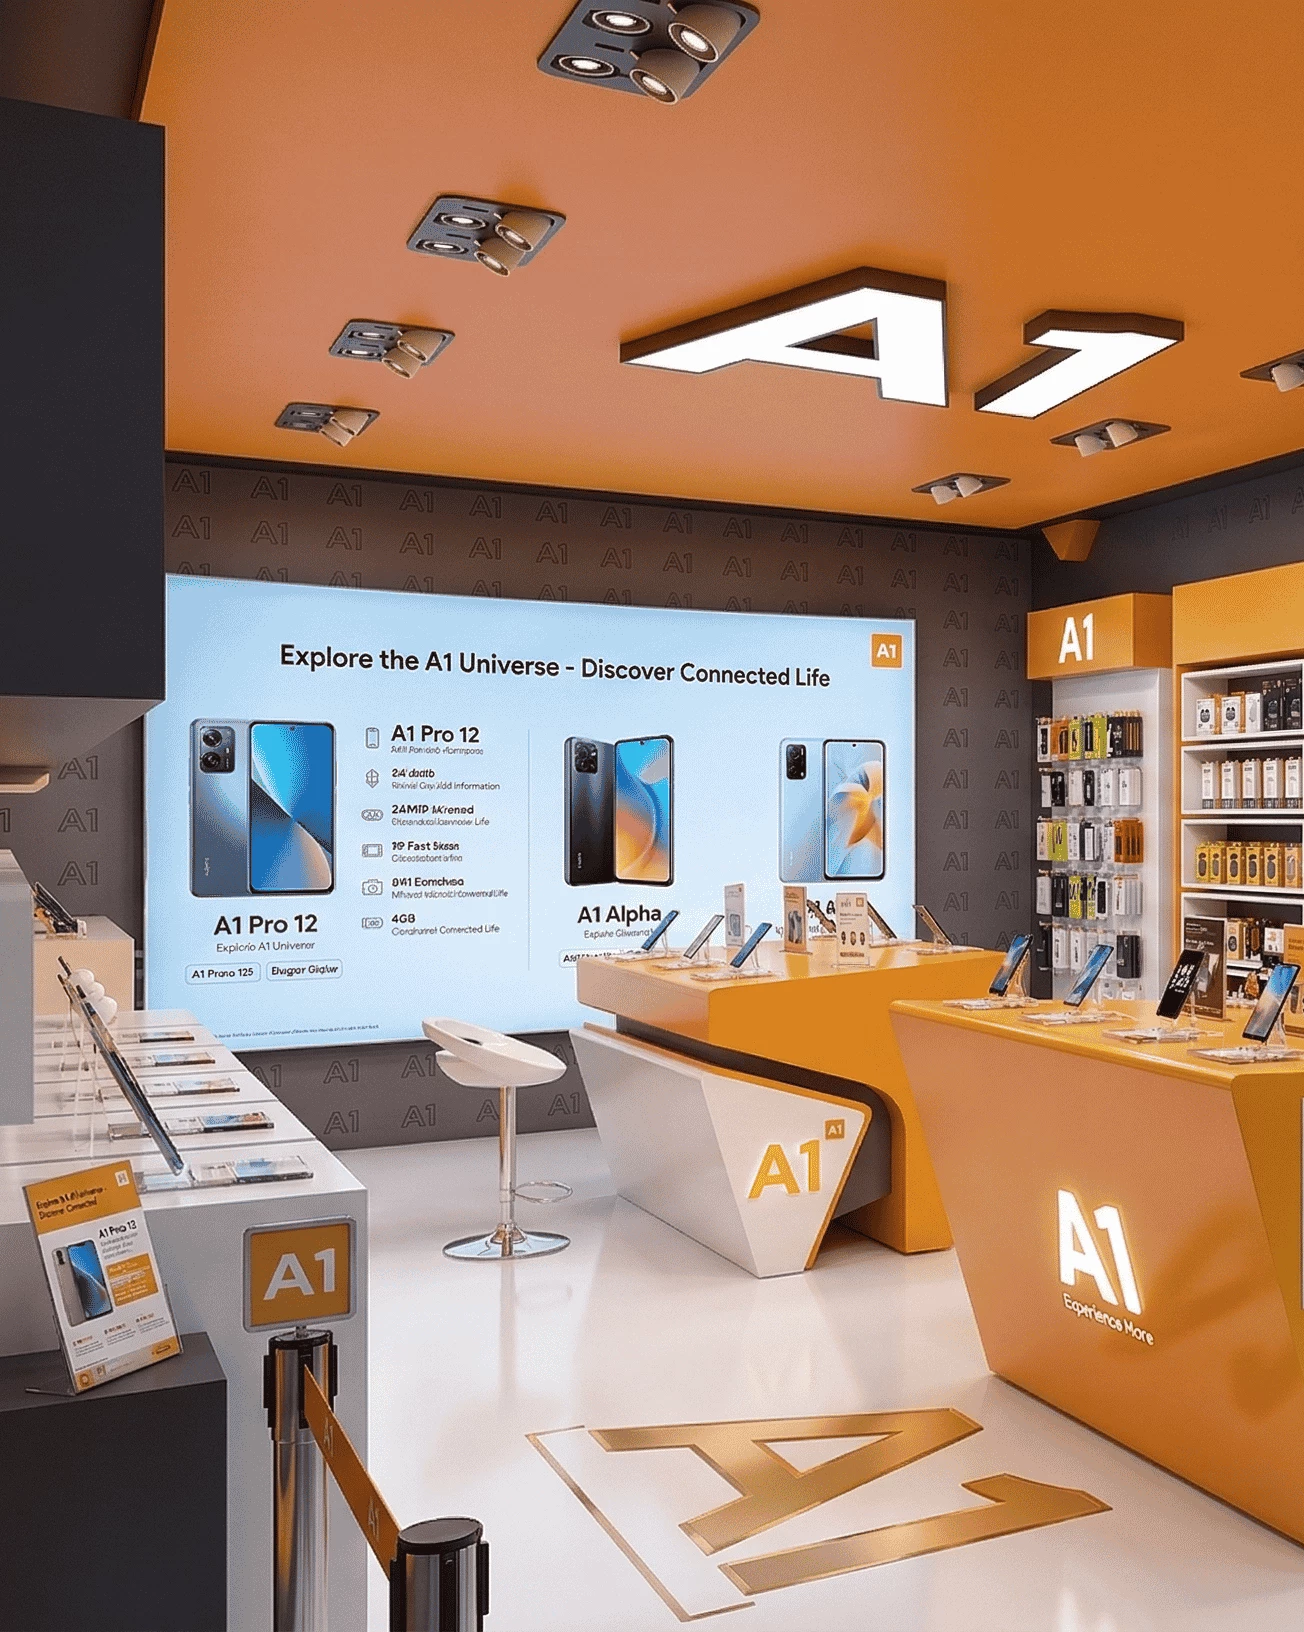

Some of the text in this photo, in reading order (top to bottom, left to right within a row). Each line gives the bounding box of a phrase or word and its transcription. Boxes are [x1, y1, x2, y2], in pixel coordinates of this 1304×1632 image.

[619, 286, 1184, 419] A1
[172, 469, 211, 494] A1
[251, 476, 288, 500] A1
[327, 483, 362, 507] A1
[400, 489, 433, 513] A1
[469, 495, 501, 518] A1
[536, 500, 568, 524] A1
[172, 515, 211, 540] A1
[601, 507, 632, 529] A1
[663, 512, 693, 535] A1
[723, 517, 752, 539] A1
[251, 521, 288, 545] A1
[327, 526, 362, 550] A1
[400, 532, 433, 556] A1
[781, 523, 809, 544] A1
[837, 527, 864, 548] A1
[891, 531, 917, 552] A1
[469, 537, 501, 560] A1
[536, 542, 568, 565] A1
[943, 536, 969, 557] A1
[994, 540, 1019, 561] A1
[601, 547, 632, 569] A1
[663, 552, 693, 574] A1
[723, 556, 752, 578] A1
[781, 561, 809, 582] A1
[837, 565, 864, 586] A1
[891, 568, 917, 589] A1
[943, 572, 969, 592] A1
[994, 576, 1019, 596] A1
[943, 610, 969, 630] A1
[994, 613, 1019, 633] A1
[1058, 613, 1094, 663] A1
[875, 643, 897, 659] A1
[943, 648, 968, 667] A1
[995, 650, 1019, 670] A1
[280, 644, 374, 672] Explore
[379, 649, 420, 671] the
[425, 651, 452, 672] A1
[459, 652, 560, 677] Universe
[581, 658, 675, 683] Discover
[680, 662, 791, 687] Connected
[795, 668, 831, 688] Life
[943, 687, 968, 706] A1
[995, 689, 1019, 709] A1
[391, 725, 480, 743] A1 Pro 12
[943, 728, 968, 747] A1
[995, 729, 1019, 748] A1
[58, 755, 98, 779] A1
[943, 769, 968, 788] A1
[995, 770, 1019, 789] A1
[58, 808, 98, 832] A1
[943, 810, 968, 829] A1
[995, 810, 1019, 829] A1
[407, 842, 431, 851] Fast
[943, 852, 968, 871] A1
[995, 851, 1019, 870] A1
[58, 861, 98, 886] A1
[943, 892, 968, 911] A1
[995, 891, 1019, 910] A1
[213, 914, 318, 935] A1 Pro 12
[577, 904, 662, 927] A1 Alpha
[258, 942, 270, 952] A1
[191, 970, 205, 979] A1
[323, 1059, 360, 1084] A1
[401, 1055, 436, 1079] A1
[549, 1092, 581, 1116] A1
[323, 1110, 360, 1134] A1
[401, 1104, 436, 1128] A1
[827, 1124, 843, 1136] A1
[747, 1139, 821, 1199] A1
[1057, 1189, 1142, 1316] A1
[263, 1247, 337, 1302] A1
[588, 1407, 1113, 1597] A1
